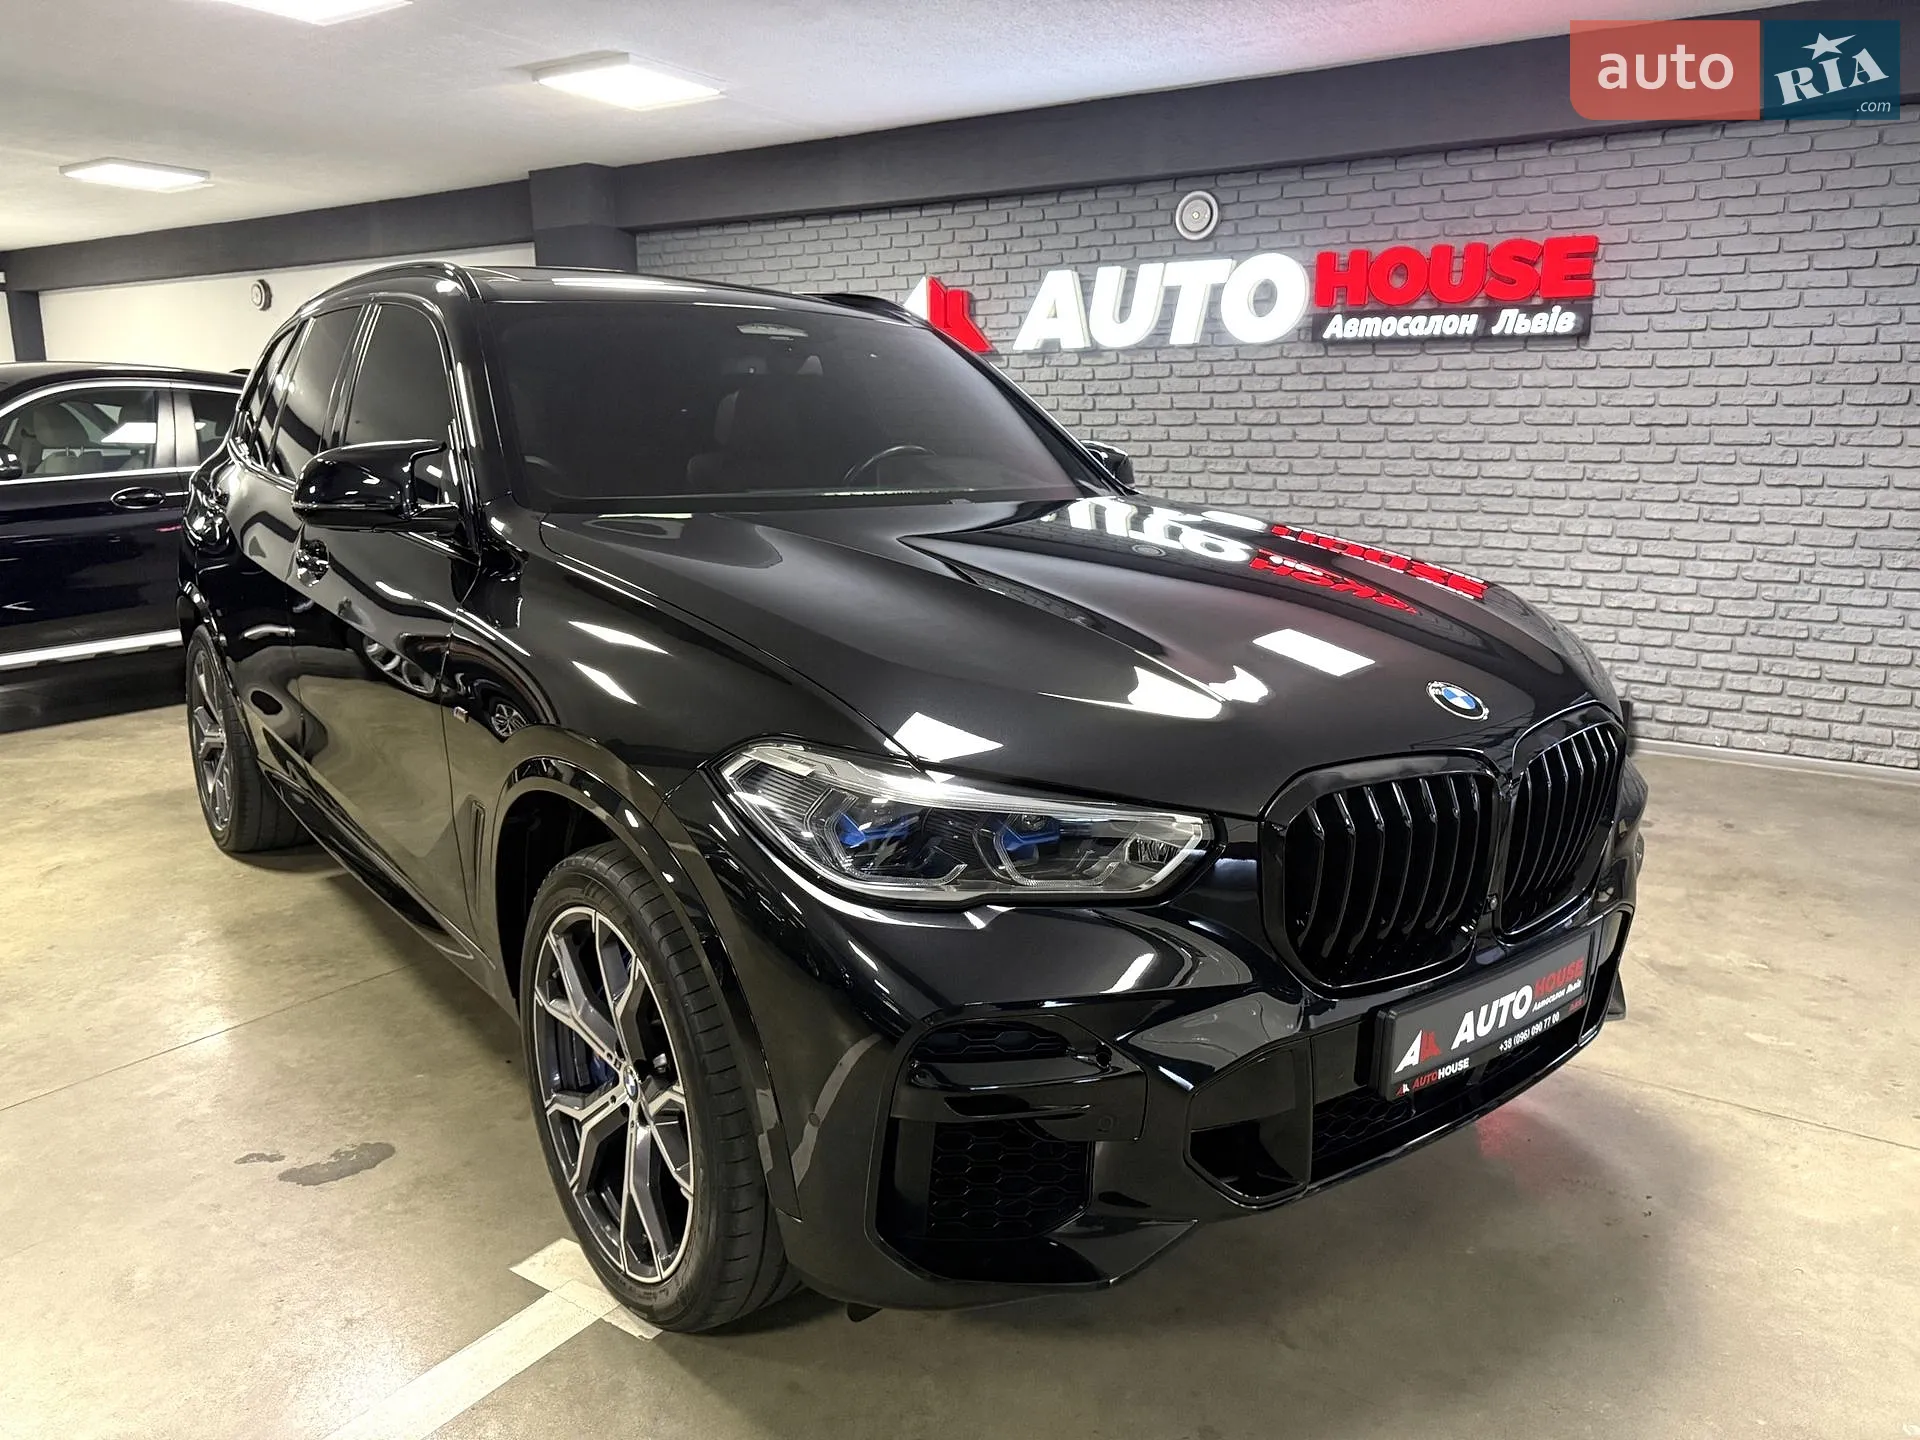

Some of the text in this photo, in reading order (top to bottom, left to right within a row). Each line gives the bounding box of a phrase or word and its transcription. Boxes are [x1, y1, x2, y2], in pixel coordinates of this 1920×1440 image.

[1012, 235, 1598, 352] AUTO HOUSE
[1323, 305, 1576, 339] Автосалон Львів
[1451, 985, 1533, 1051] AUTO
[1534, 956, 1584, 997] HOUSE
